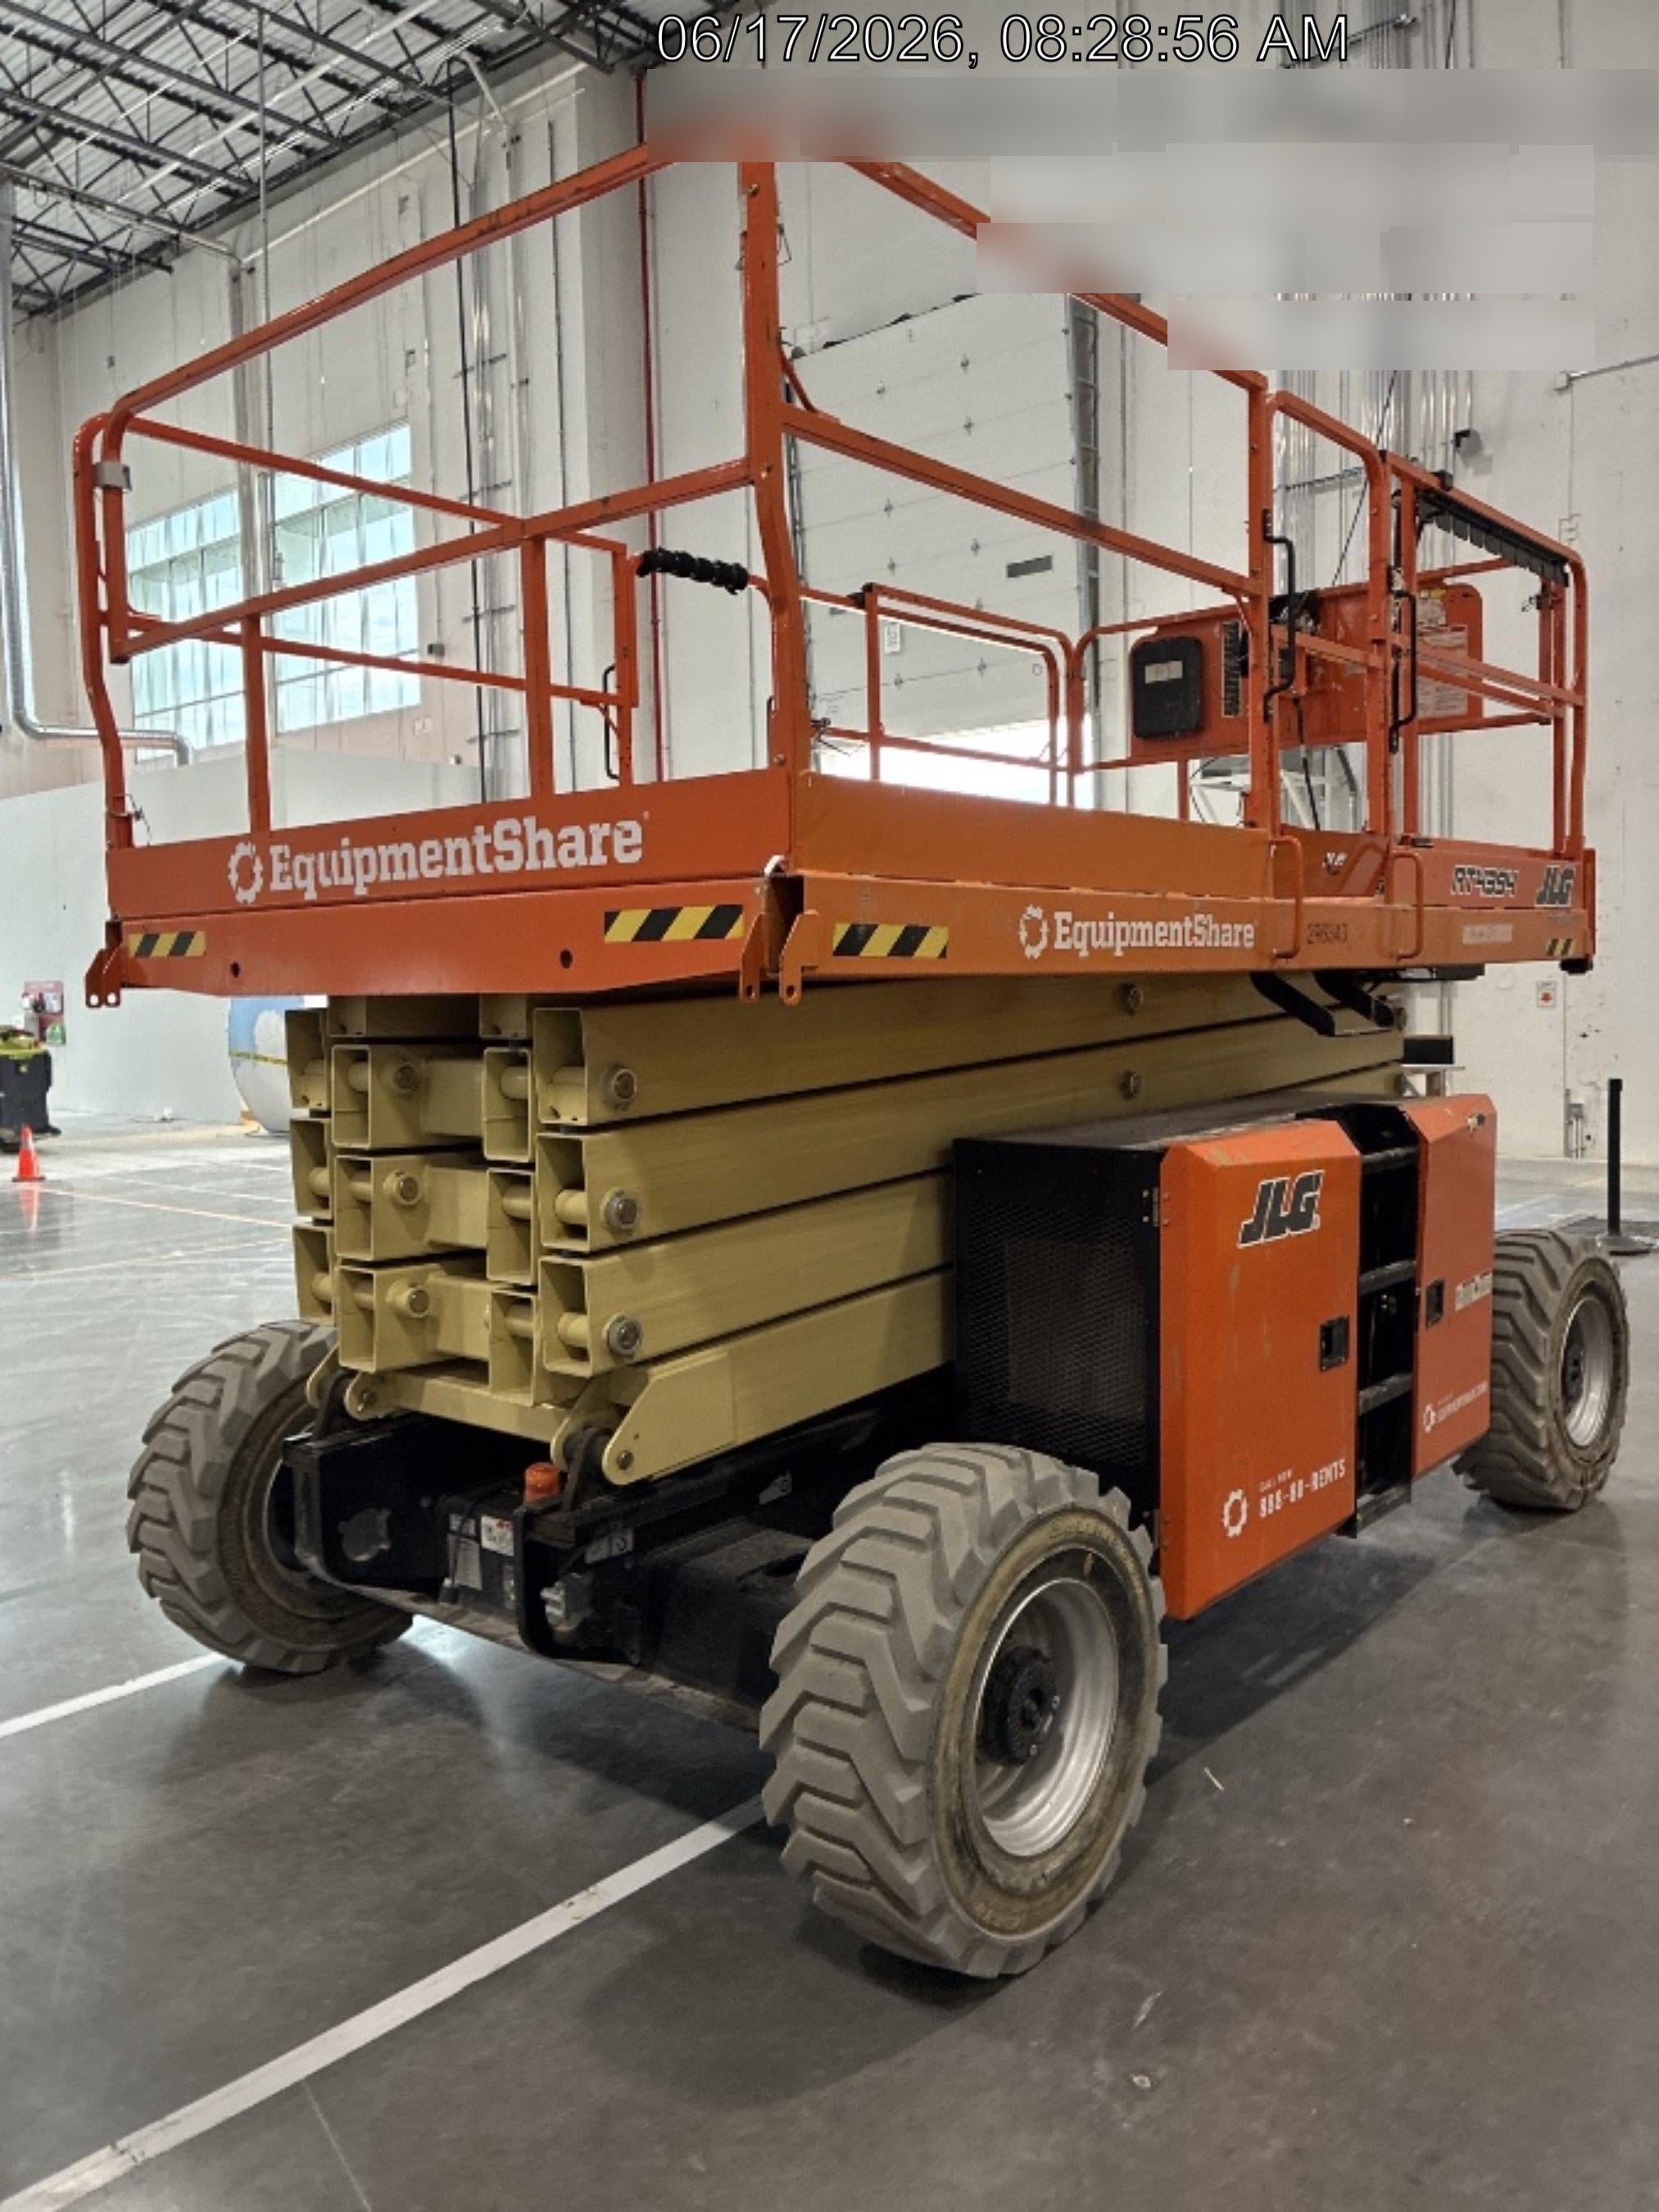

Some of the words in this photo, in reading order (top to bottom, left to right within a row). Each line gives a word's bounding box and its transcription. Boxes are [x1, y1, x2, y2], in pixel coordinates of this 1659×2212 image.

[270, 815, 642, 900] EquipmentShare
[1534, 864, 1576, 909] JLG
[1054, 911, 1255, 957] EquipmentShare
[1236, 1168, 1325, 1249] JLG
